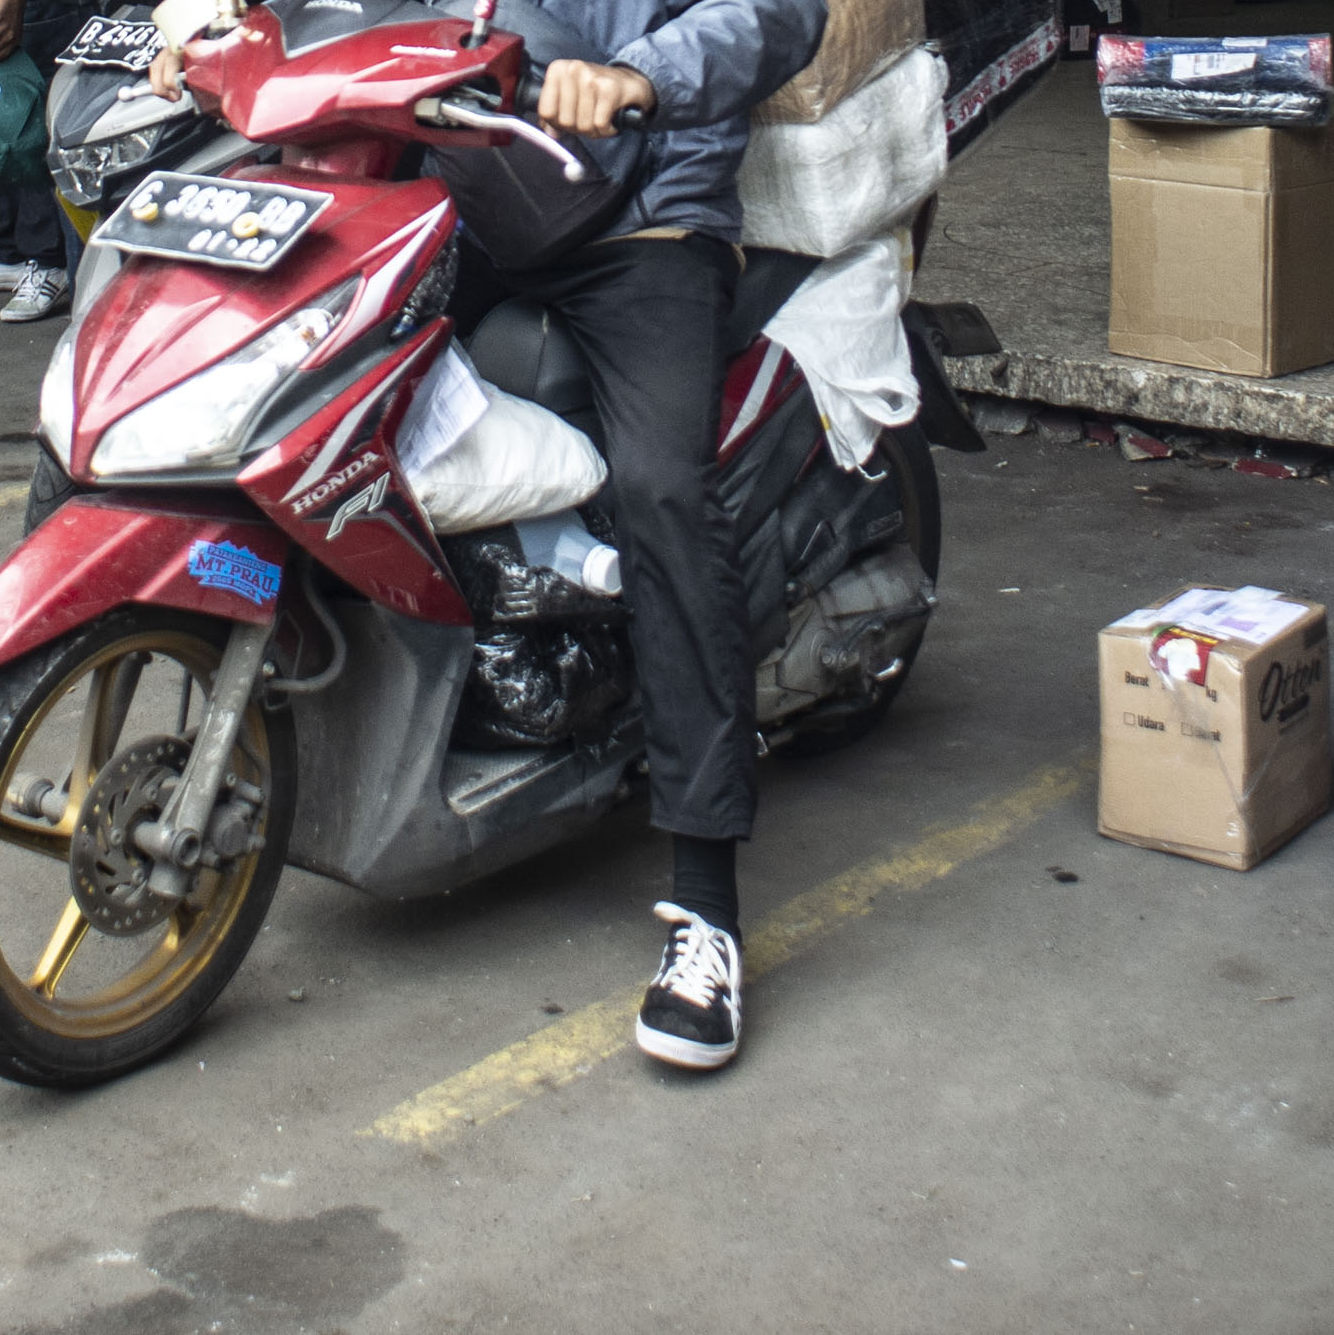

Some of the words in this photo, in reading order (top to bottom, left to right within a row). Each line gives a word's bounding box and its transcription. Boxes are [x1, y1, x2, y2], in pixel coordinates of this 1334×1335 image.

[79, 21, 104, 45] B
[290, 450, 380, 515] HONDA
[1136, 714, 1166, 732] Udara
